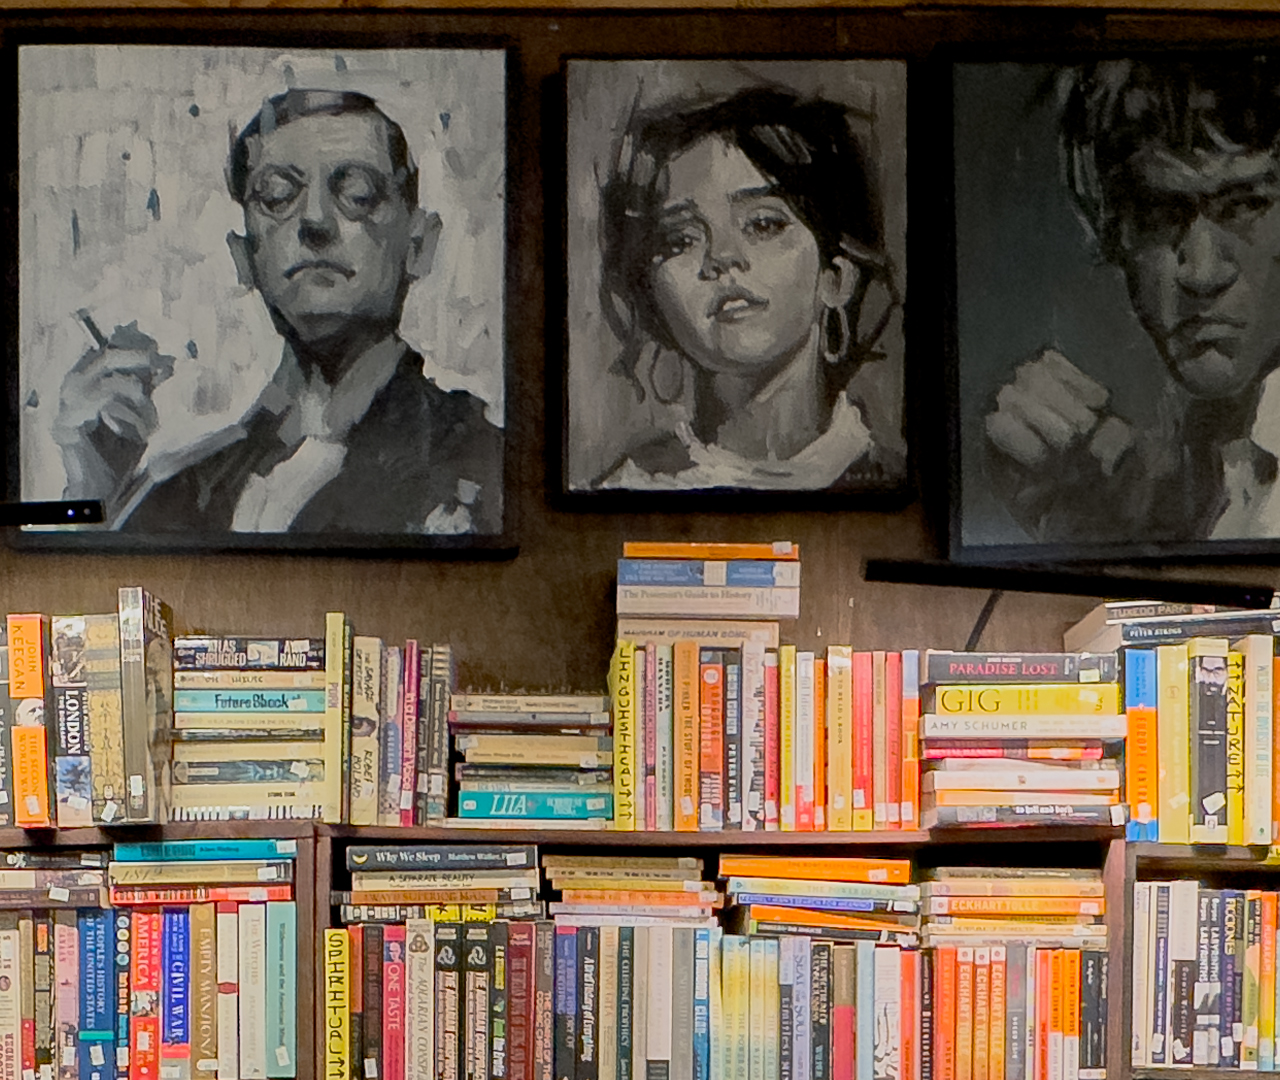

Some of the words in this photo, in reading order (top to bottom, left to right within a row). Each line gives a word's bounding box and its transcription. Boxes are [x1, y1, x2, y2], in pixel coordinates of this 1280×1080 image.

[13, 625, 26, 690] KEEGAN
[27, 641, 37, 672] JOHN
[196, 653, 247, 668] SHRUGGED
[280, 654, 307, 668] RAND
[949, 662, 1017, 676] PARADISE
[1021, 662, 1058, 676] LOST
[215, 694, 249, 709] Future
[252, 693, 289, 710] Shock
[940, 689, 1002, 713] GIG
[64, 690, 81, 754] LONDON
[930, 721, 958, 731] AMY
[964, 721, 1028, 731] SCHUMER
[1135, 717, 1147, 758] EUROPE
[1227, 685, 1242, 766] NATURE
[951, 899, 1002, 912] ECKHART
[1004, 899, 1039, 912] TOLLE
[1223, 896, 1237, 955] FICCIONES
[96, 924, 106, 967] PEOPLE'S
[136, 914, 150, 986] AMERICA
[199, 928, 213, 974] EMPTY
[1263, 925, 1274, 976] MURAKAMI
[170, 961, 185, 1001] CIVIL
[388, 965, 400, 997] ONE
[793, 954, 807, 985] SEAT
[96, 970, 106, 1014] HISTORY
[327, 933, 345, 1056] SPIRITUAL
[959, 964, 971, 1020] ECKHART
[976, 967, 988, 1021] ECKHART
[991, 964, 1003, 1020] ECKHART
[170, 1004, 184, 1036] WAR
[200, 980, 214, 1056] MANSIONS
[388, 998, 401, 1030] TASTE
[794, 1005, 807, 1041] SOUL
[959, 1022, 971, 1056] TOLLE
[976, 1024, 988, 1060] TOLLE
[991, 1023, 1003, 1056] TOLLE
